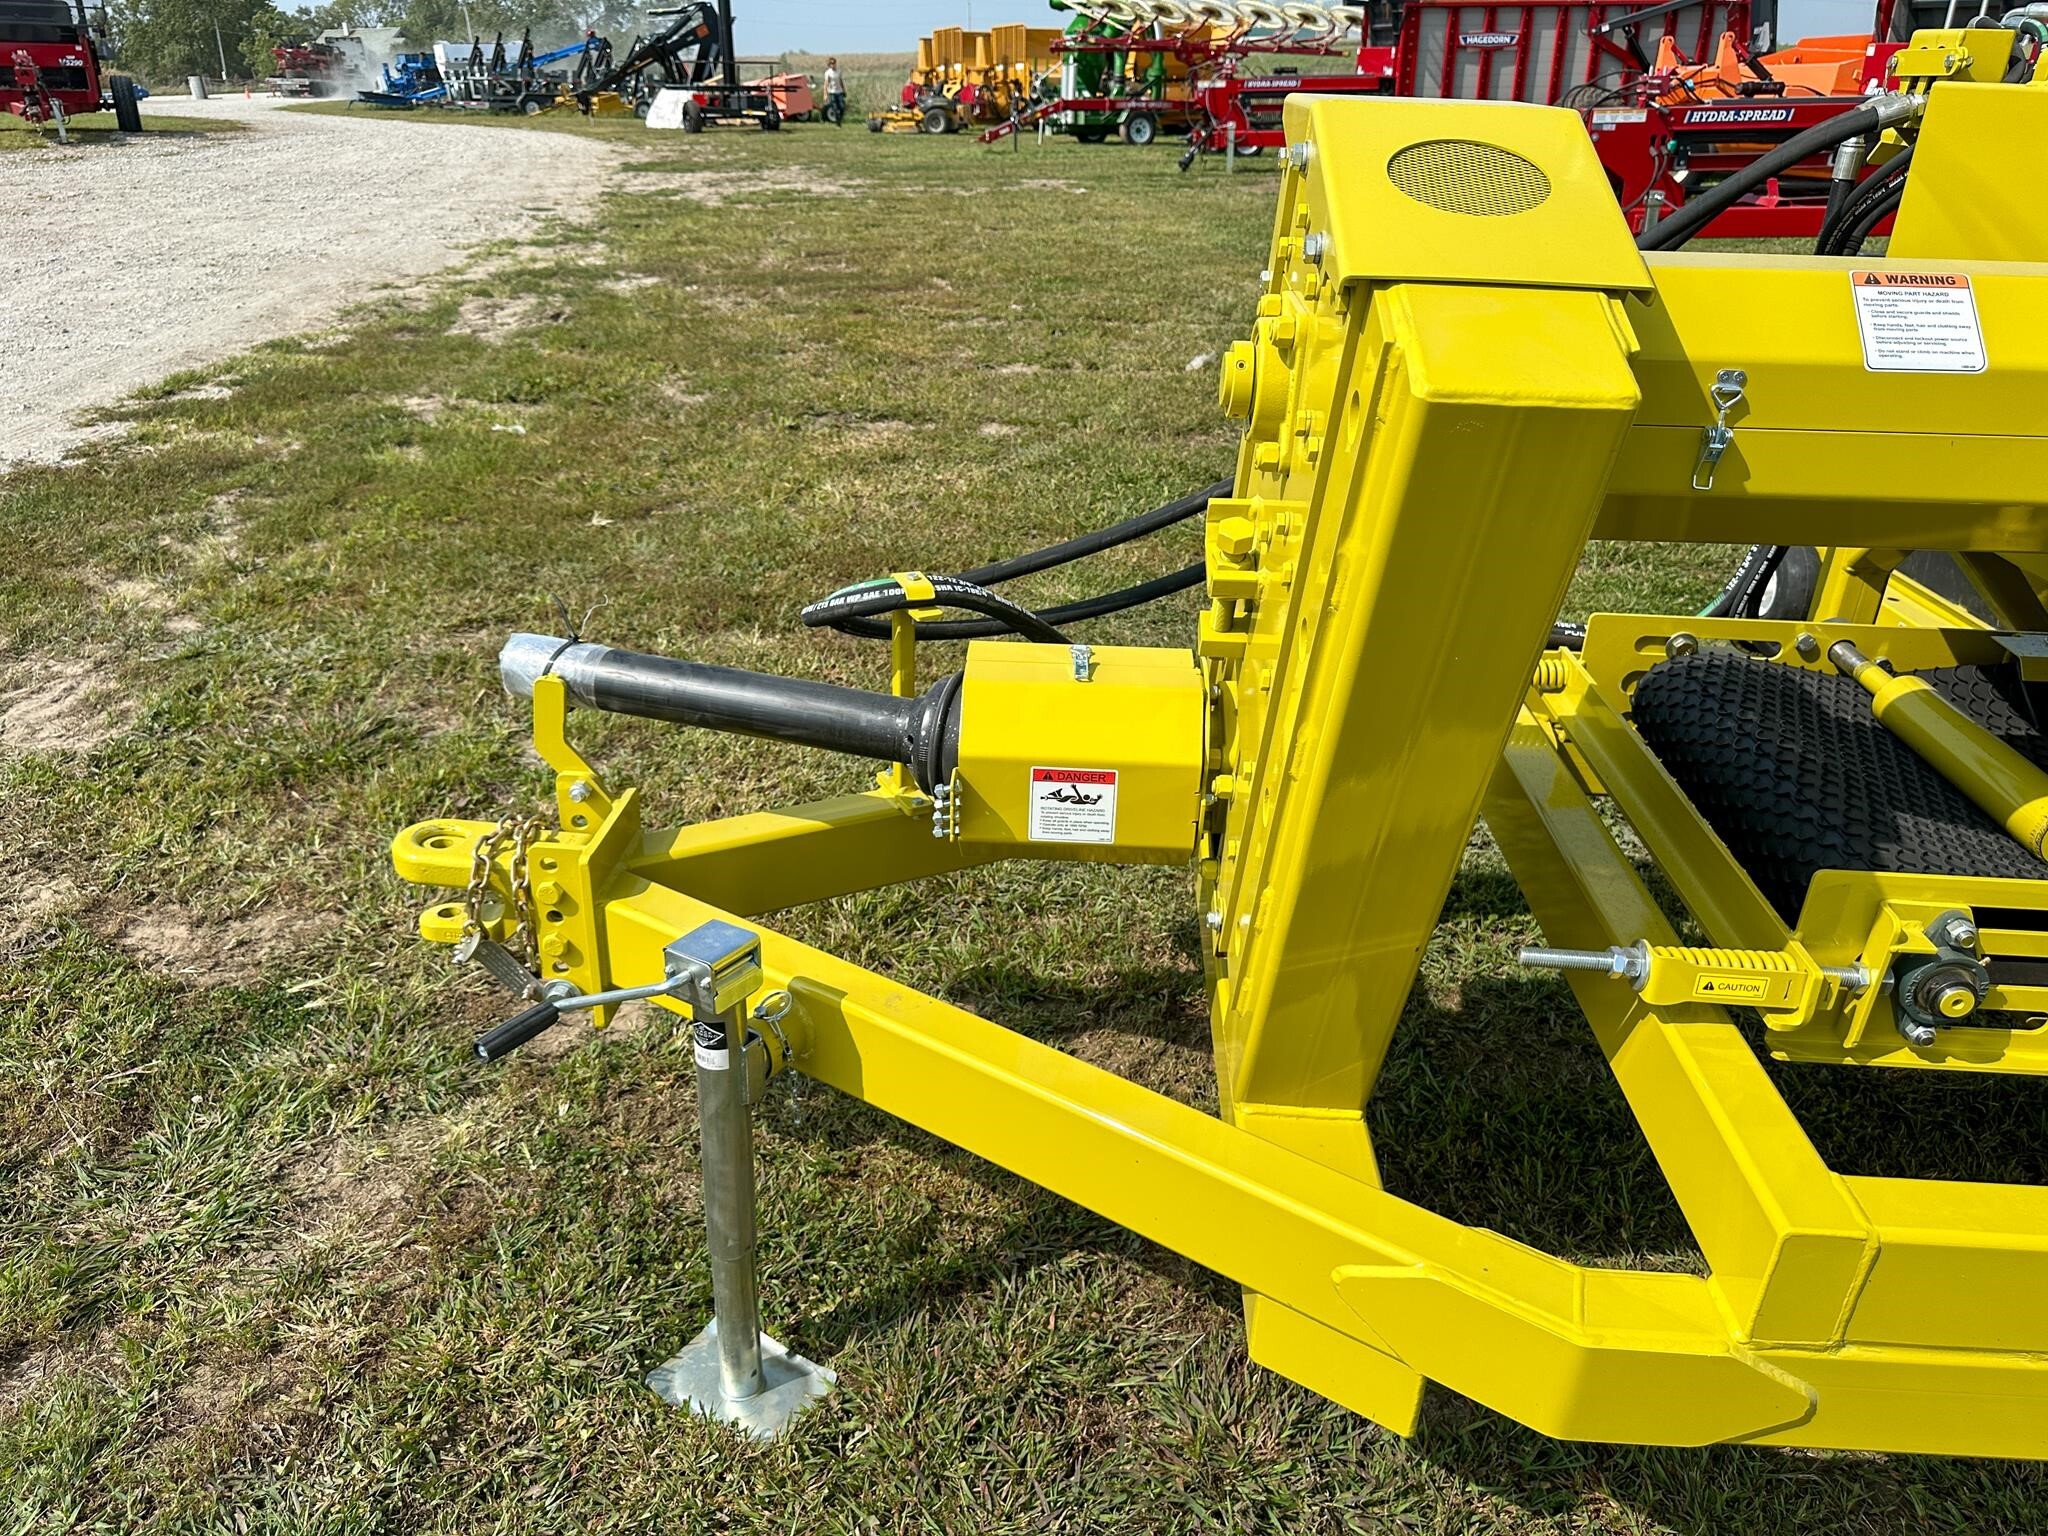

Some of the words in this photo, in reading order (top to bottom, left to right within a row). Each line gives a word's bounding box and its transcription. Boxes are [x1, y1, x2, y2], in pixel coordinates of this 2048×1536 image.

[1466, 36, 1511, 44] HAGEDORN
[1690, 110, 1787, 122] HYDRA-SPREAD
[1885, 274, 1956, 285] WARNING
[1057, 772, 1106, 782] DANGER
[1718, 982, 1760, 992] CAUTION
